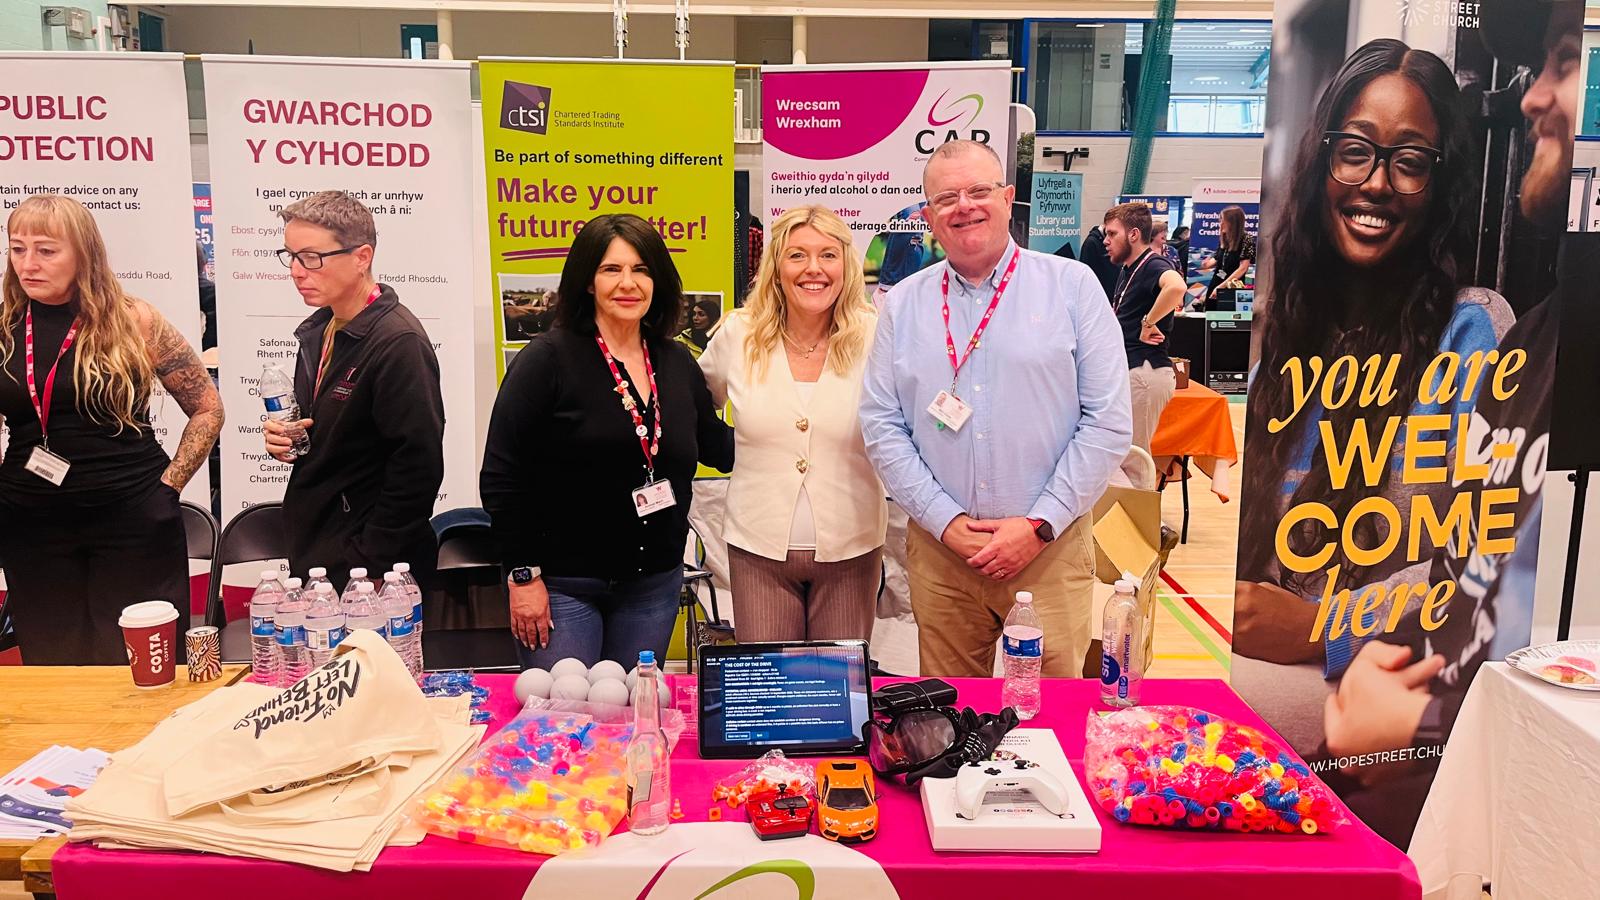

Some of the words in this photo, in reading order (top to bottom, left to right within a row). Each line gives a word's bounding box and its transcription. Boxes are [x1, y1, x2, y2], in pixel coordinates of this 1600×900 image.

[1434, 0, 1481, 15] STREET
[1432, 14, 1480, 29] CHURCH
[0, 95, 107, 120] PUBLIC
[776, 99, 841, 111] Wrecsam
[243, 99, 433, 128] GWARCHOD
[508, 101, 545, 127] ctsi
[554, 110, 590, 119] Chartered
[593, 111, 620, 121] Trading
[554, 119, 591, 128] Standards
[593, 120, 625, 129] Institute
[776, 117, 842, 129] Wrexham
[246, 138, 267, 164] Y
[275, 141, 431, 168] CYHOEDD
[494, 149, 514, 163] Be
[519, 150, 550, 165] part
[554, 151, 570, 164] of
[574, 151, 655, 168] something
[659, 152, 723, 166] different
[771, 172, 817, 181] Gweithio
[818, 171, 855, 183] gyda'n
[856, 171, 890, 183] gilydd
[776, 185, 803, 194] herio
[804, 185, 827, 196] yfed
[829, 184, 870, 194] alcohol
[880, 185, 901, 194] dan
[903, 185, 922, 194] oed
[1038, 178, 1067, 190] Llyfrgell
[23, 185, 60, 195] further
[63, 186, 99, 196] advice
[102, 187, 116, 196] on
[119, 187, 139, 198] any
[262, 187, 286, 199] gael
[371, 192, 381, 200] ar
[385, 191, 424, 202] unrhyw
[497, 178, 577, 203] Make
[587, 185, 658, 211] your
[1035, 190, 1072, 202] Chymorth
[125, 202, 141, 210] us:
[390, 205, 396, 214] â
[400, 206, 412, 214] ni:
[1040, 201, 1071, 213] Fyfyrwyr
[497, 212, 586, 238] future
[1036, 215, 1060, 227] Library
[1061, 216, 1075, 225] and
[231, 226, 255, 235] Ebost:
[1029, 226, 1055, 236] Student
[231, 249, 251, 257] Ffôn:
[145, 272, 173, 281] Road,
[233, 272, 253, 281] Galw
[378, 274, 406, 283] Ffordd
[259, 338, 297, 348] Safonau
[257, 350, 283, 359] Rhent
[1267, 353, 1402, 434] you
[1417, 348, 1528, 406] are
[1318, 412, 1517, 490] WEL-
[1274, 487, 1521, 574] COME
[1308, 563, 1457, 644] here
[149, 632, 163, 674] COSTA
[1123, 633, 1131, 674] smartwater
[312, 659, 350, 692] LEFT
[326, 659, 360, 707] No
[244, 678, 311, 719] BEHIND
[254, 690, 326, 740] Friend
